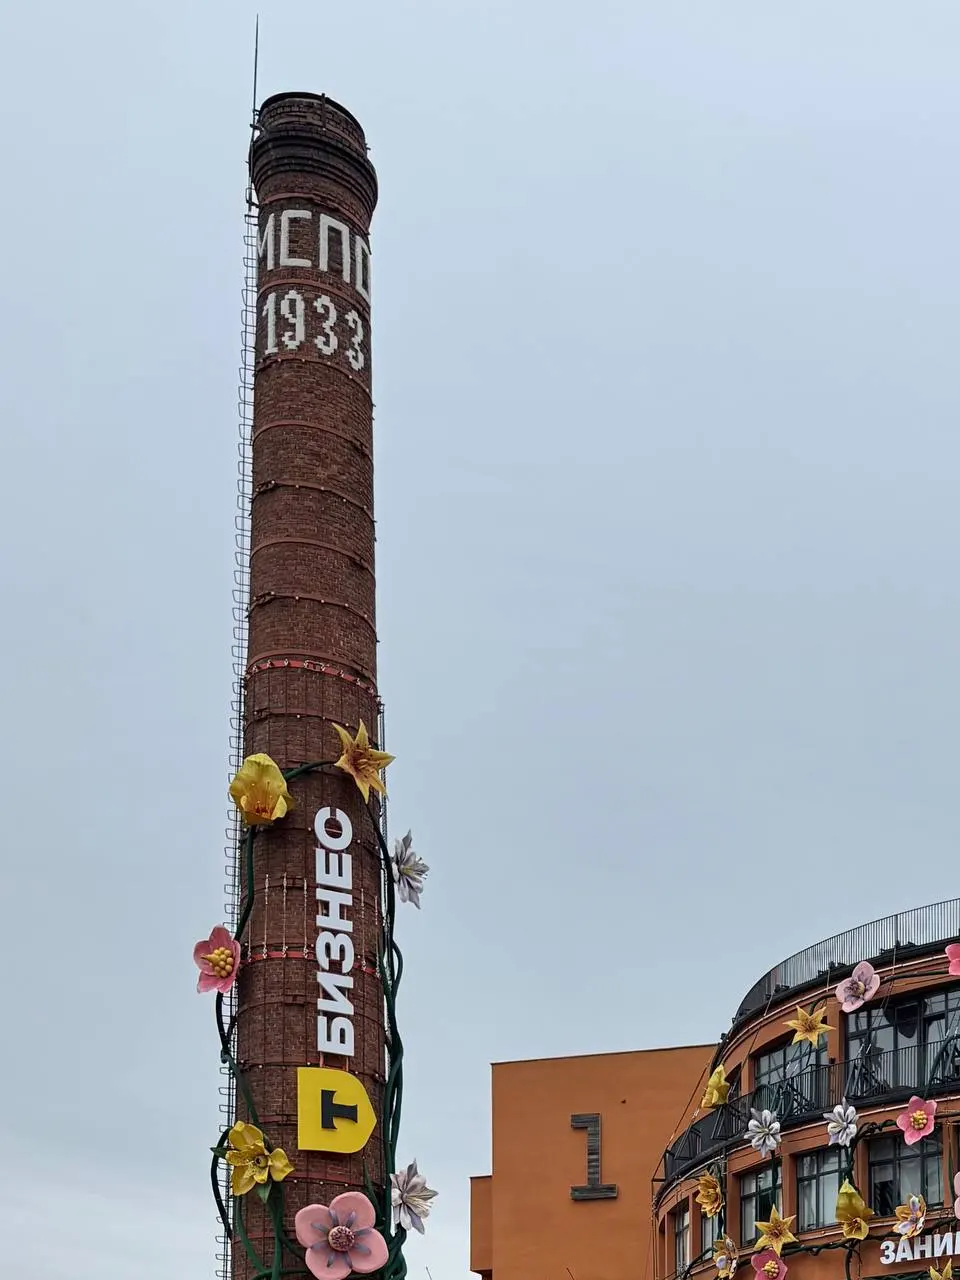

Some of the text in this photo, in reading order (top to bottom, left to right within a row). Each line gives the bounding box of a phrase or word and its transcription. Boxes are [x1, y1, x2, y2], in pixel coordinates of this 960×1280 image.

[262, 290, 365, 371] 1933
[314, 806, 358, 1130] Т БИЗНЕС
[571, 1112, 618, 1201] 1
